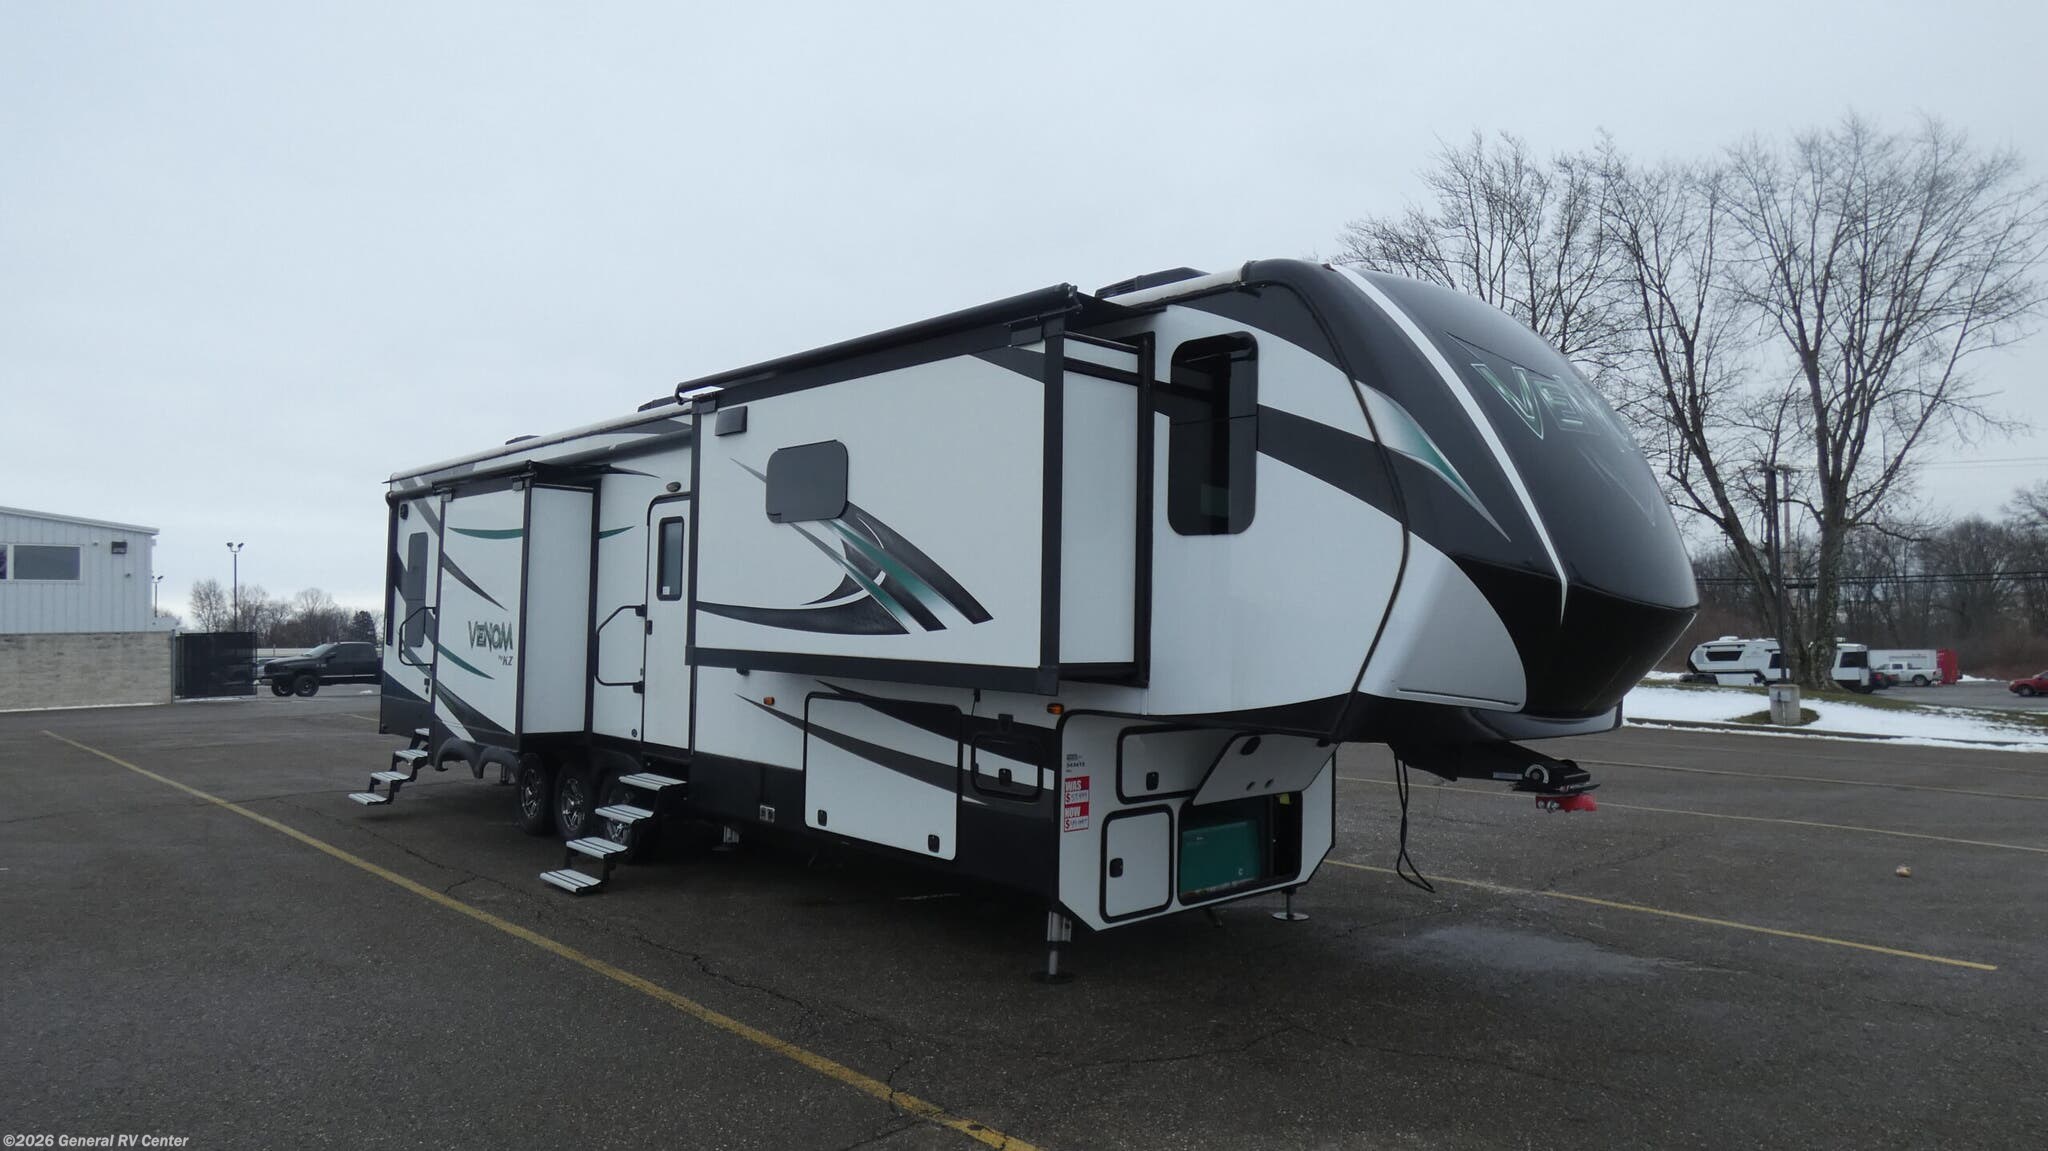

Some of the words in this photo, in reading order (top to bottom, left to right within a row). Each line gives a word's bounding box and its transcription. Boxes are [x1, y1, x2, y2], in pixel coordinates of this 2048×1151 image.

[468, 620, 514, 652] VENOM
[1065, 780, 1082, 792] WAS
[1065, 806, 1081, 818] NOW
